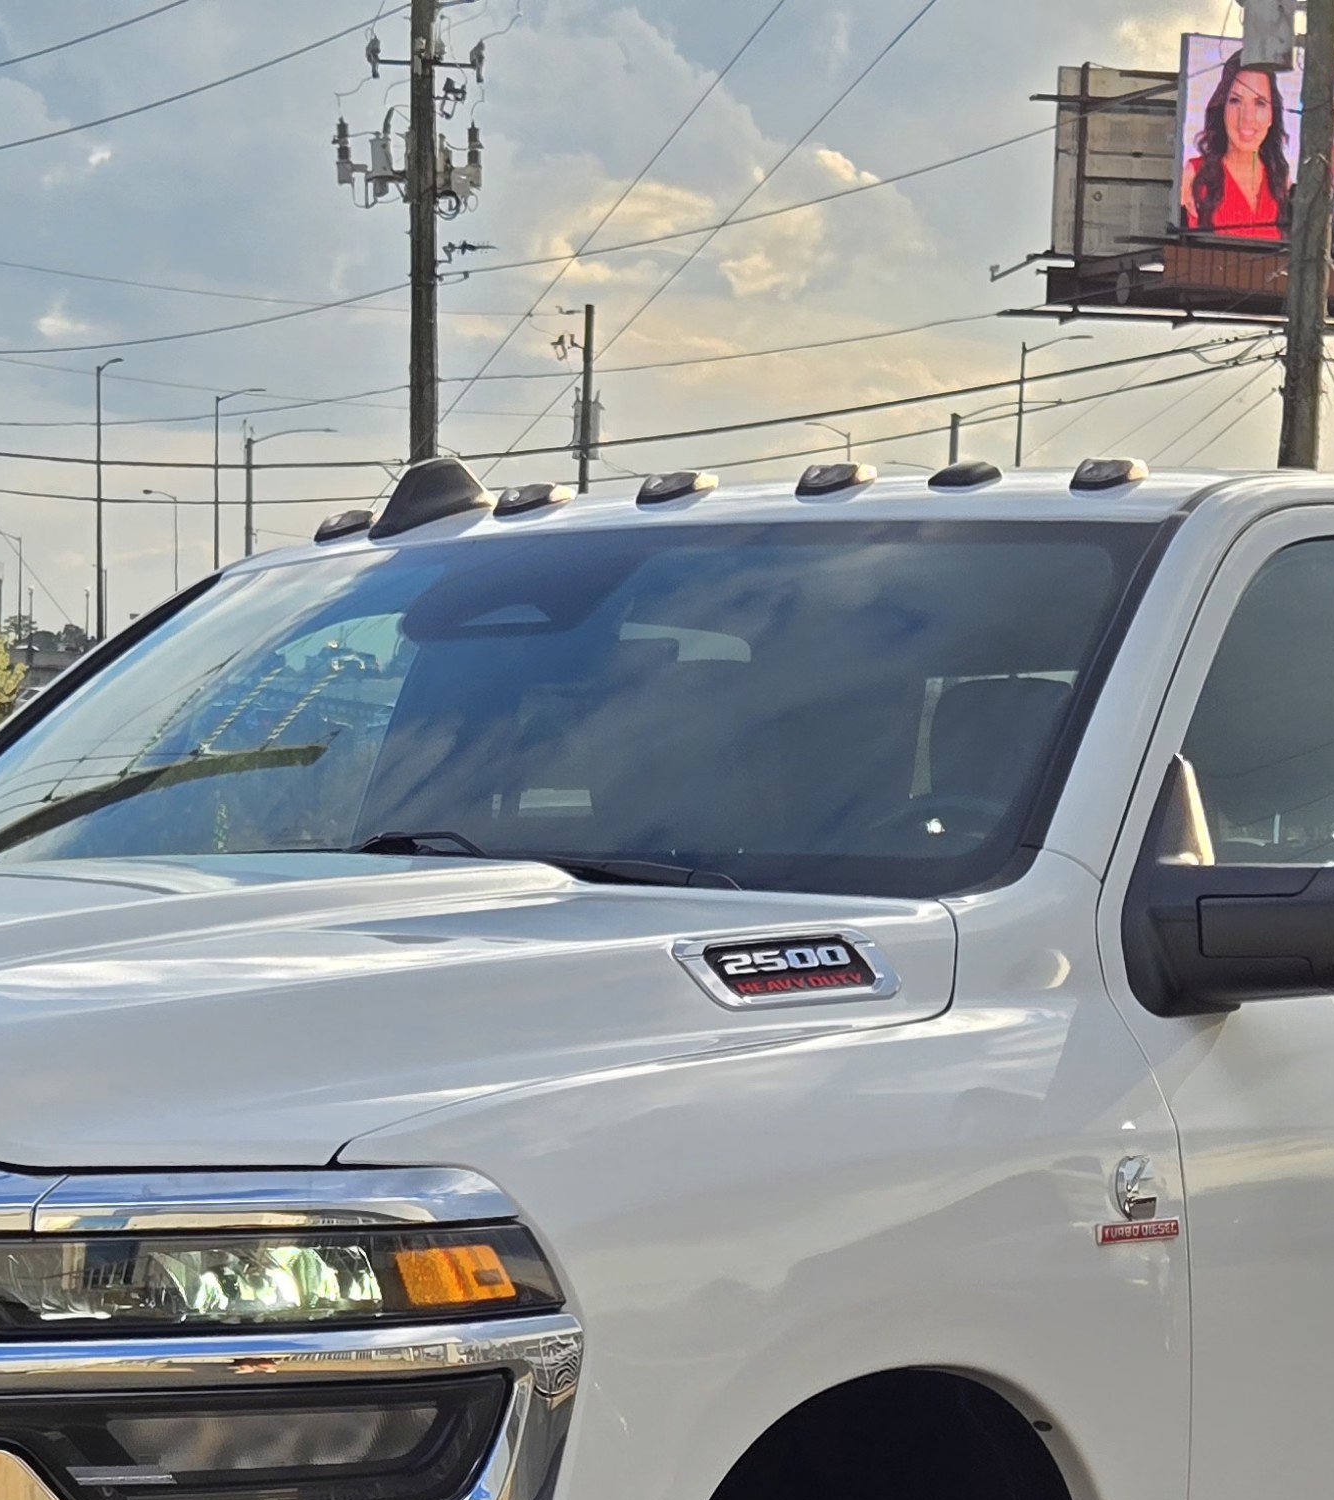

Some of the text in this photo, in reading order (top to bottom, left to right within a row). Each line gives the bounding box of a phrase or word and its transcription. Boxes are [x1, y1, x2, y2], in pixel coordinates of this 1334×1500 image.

[717, 946, 852, 975] 2500
[736, 972, 863, 994] HEAVY DUTY
[1104, 1221, 1178, 1239] TURBO DIESEL
